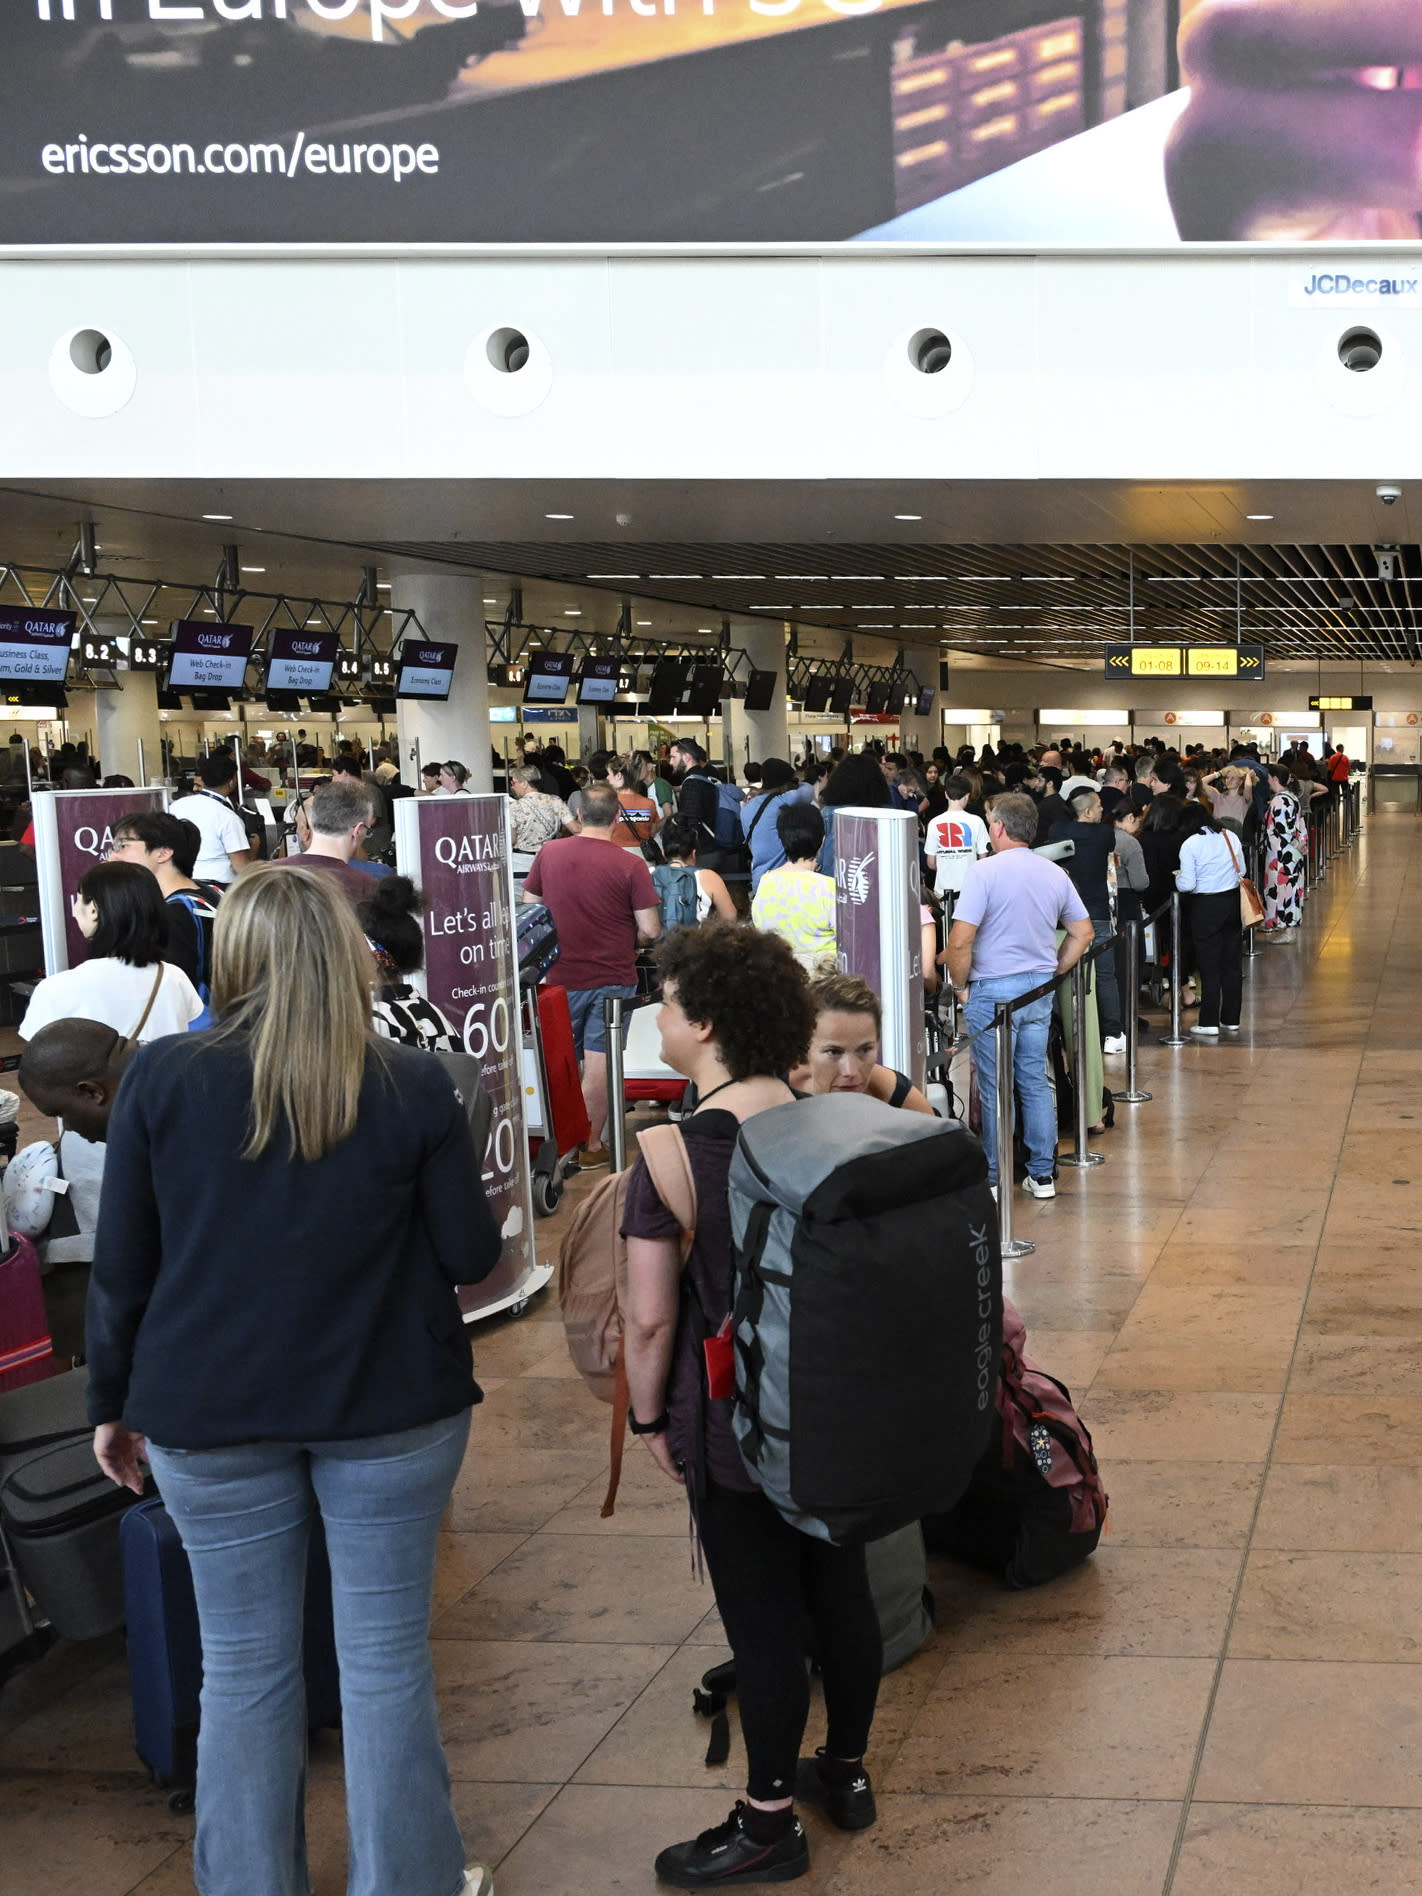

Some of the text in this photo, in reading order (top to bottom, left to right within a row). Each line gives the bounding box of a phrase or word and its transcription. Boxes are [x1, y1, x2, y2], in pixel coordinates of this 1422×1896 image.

[41, 132, 439, 182] ericsson.com/europe
[1304, 274, 1418, 295] JCDecaux
[25, 620, 56, 635] QATAR
[198, 633, 222, 646] QATAR
[291, 640, 313, 652] QATAR
[0, 649, 27, 659] usiness
[85, 643, 110, 660] 8.2
[134, 647, 157, 663] 8.3
[14, 663, 33, 674] Gold
[34, 664, 41, 674] &
[42, 664, 63, 675] Silver
[190, 658, 232, 669] Web Check-in
[341, 660, 358, 675] 8.4
[374, 662, 390, 676] 8.5
[1139, 660, 1173, 671] 01-08
[1196, 660, 1229, 671] 09-14
[194, 671, 222, 682] Bag Drop
[435, 832, 500, 869] QATAR
[456, 862, 488, 874] AIRWAYS
[430, 907, 477, 936] Let's
[460, 944, 485, 965] on
[451, 984, 487, 999] Check-in
[463, 997, 510, 1059] 60
[485, 1185, 503, 1198] efore
